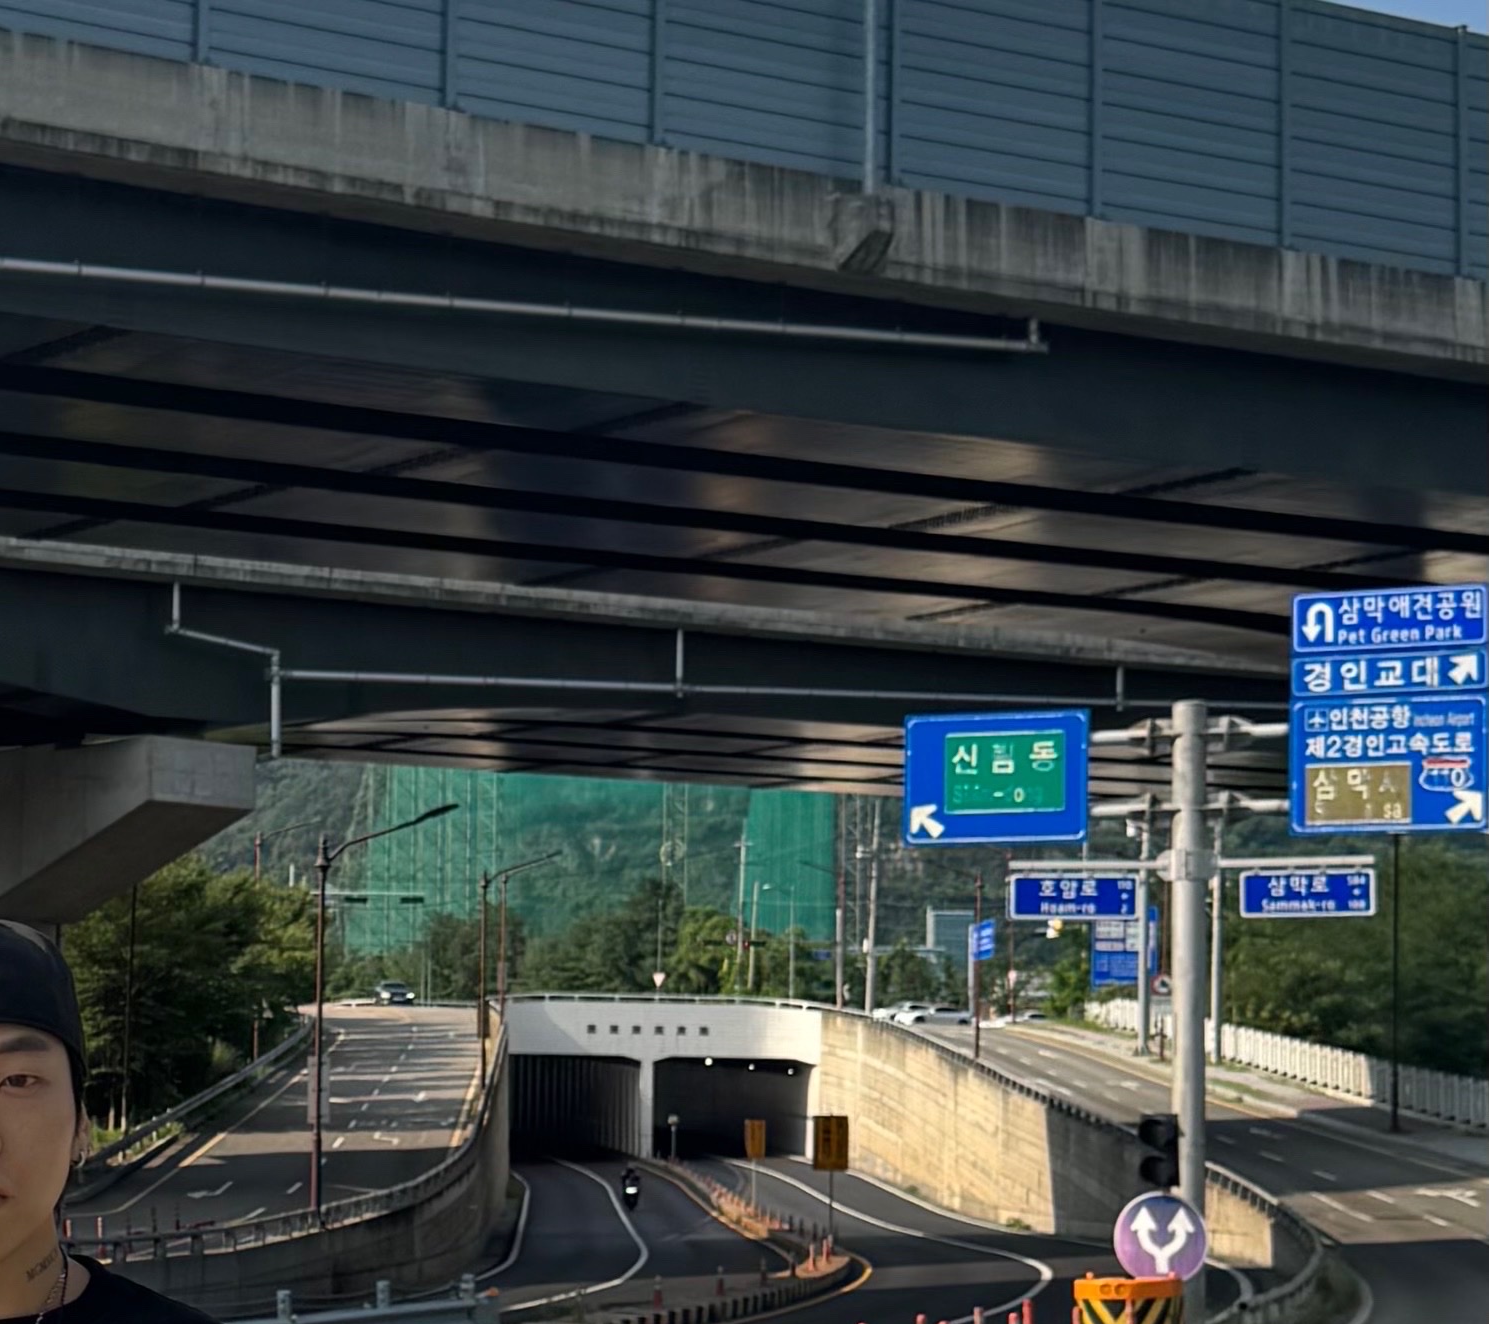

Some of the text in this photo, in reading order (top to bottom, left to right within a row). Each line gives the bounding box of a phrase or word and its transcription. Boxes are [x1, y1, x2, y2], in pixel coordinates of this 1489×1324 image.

[1338, 591, 1482, 626] 삼막애견공원
[1338, 623, 1463, 645] Pet Green Park
[1303, 655, 1439, 693] 경인교대
[1329, 704, 1411, 731] 인천공항
[1305, 731, 1475, 759] 제2경인고속도로
